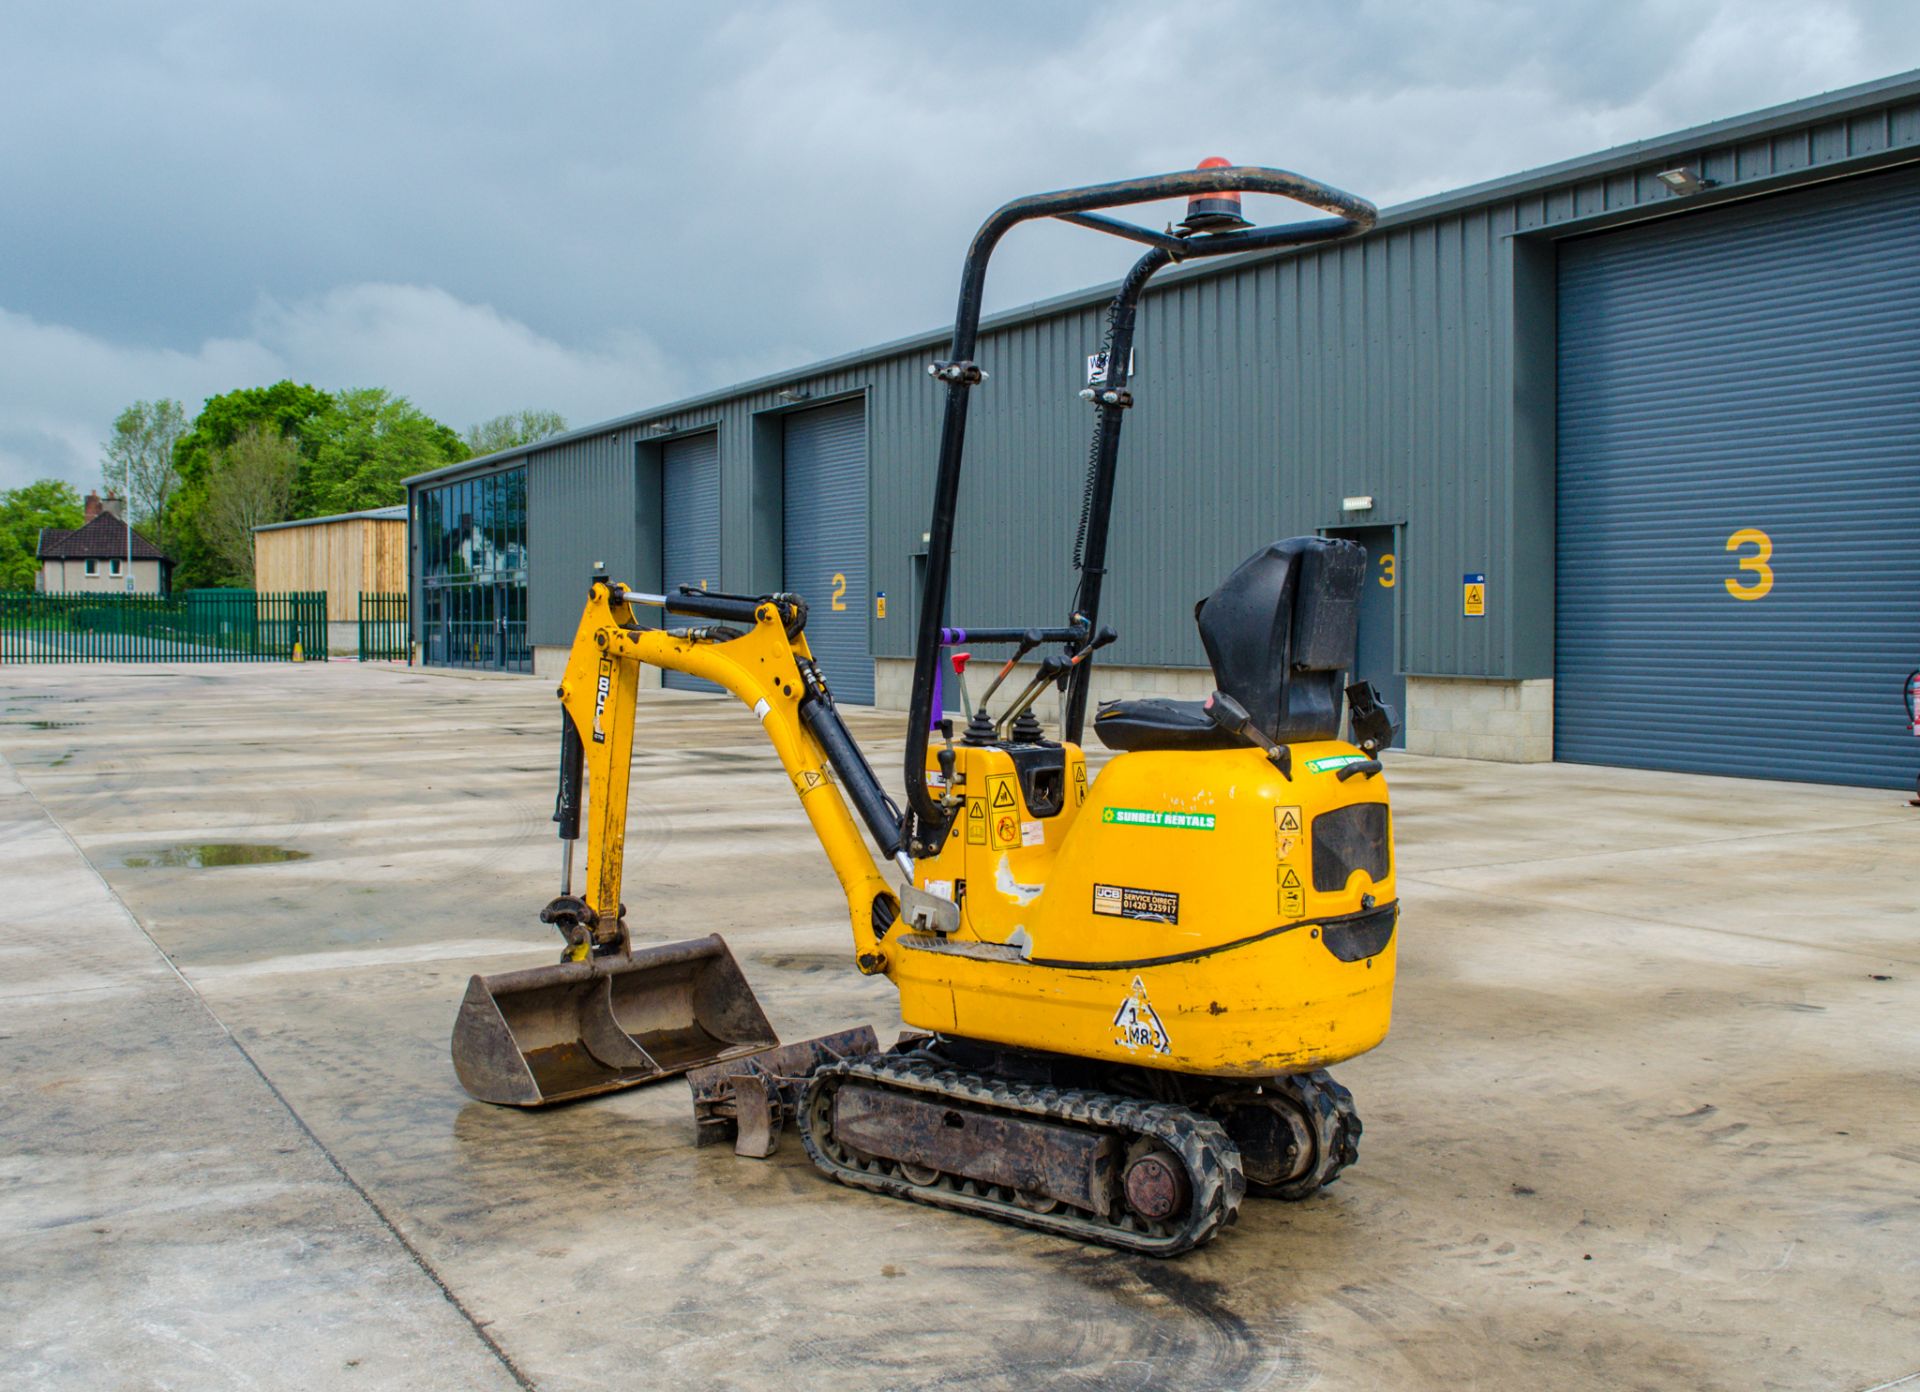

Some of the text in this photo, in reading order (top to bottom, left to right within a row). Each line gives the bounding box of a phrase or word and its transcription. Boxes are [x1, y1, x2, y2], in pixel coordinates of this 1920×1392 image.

[1379, 554, 1395, 588] 3
[1725, 528, 1774, 600] 3
[832, 573, 847, 611] 2
[1117, 811, 1215, 828] SUNBELT RENTALS
[1097, 889, 1120, 899] JCB
[1124, 893, 1151, 903] SERVICE
[1152, 896, 1177, 906] DIRECT
[1123, 900, 1147, 910] 01420
[1148, 903, 1177, 914] 525917
